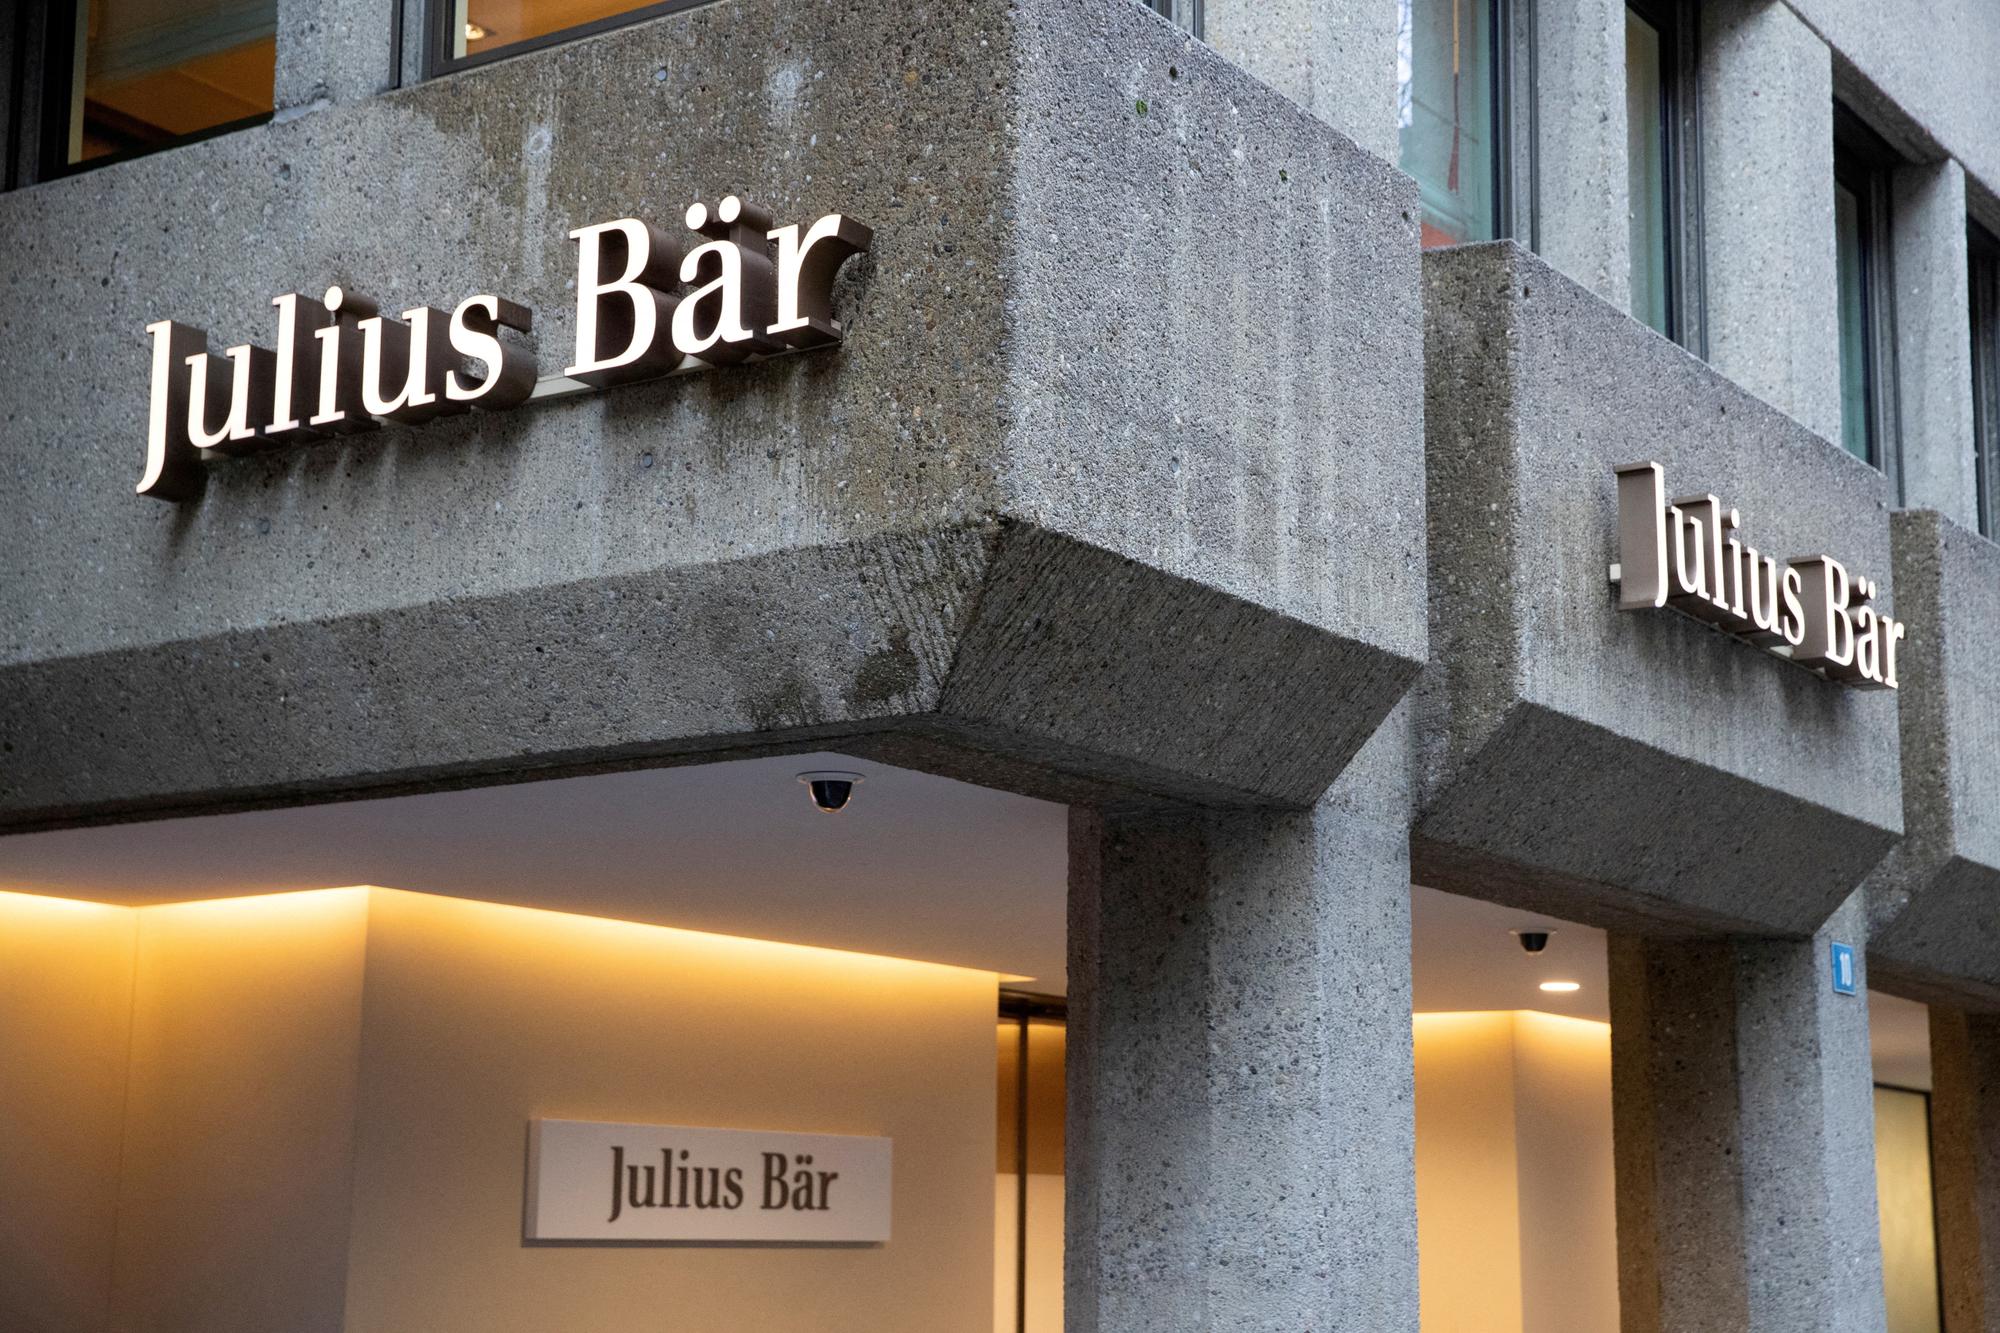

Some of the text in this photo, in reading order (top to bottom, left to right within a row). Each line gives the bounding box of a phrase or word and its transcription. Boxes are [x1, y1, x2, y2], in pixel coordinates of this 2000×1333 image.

[136, 195, 842, 495] Julius Bär
[1650, 461, 1905, 689] Julius Bär
[607, 1145, 838, 1223] Julius Bär
